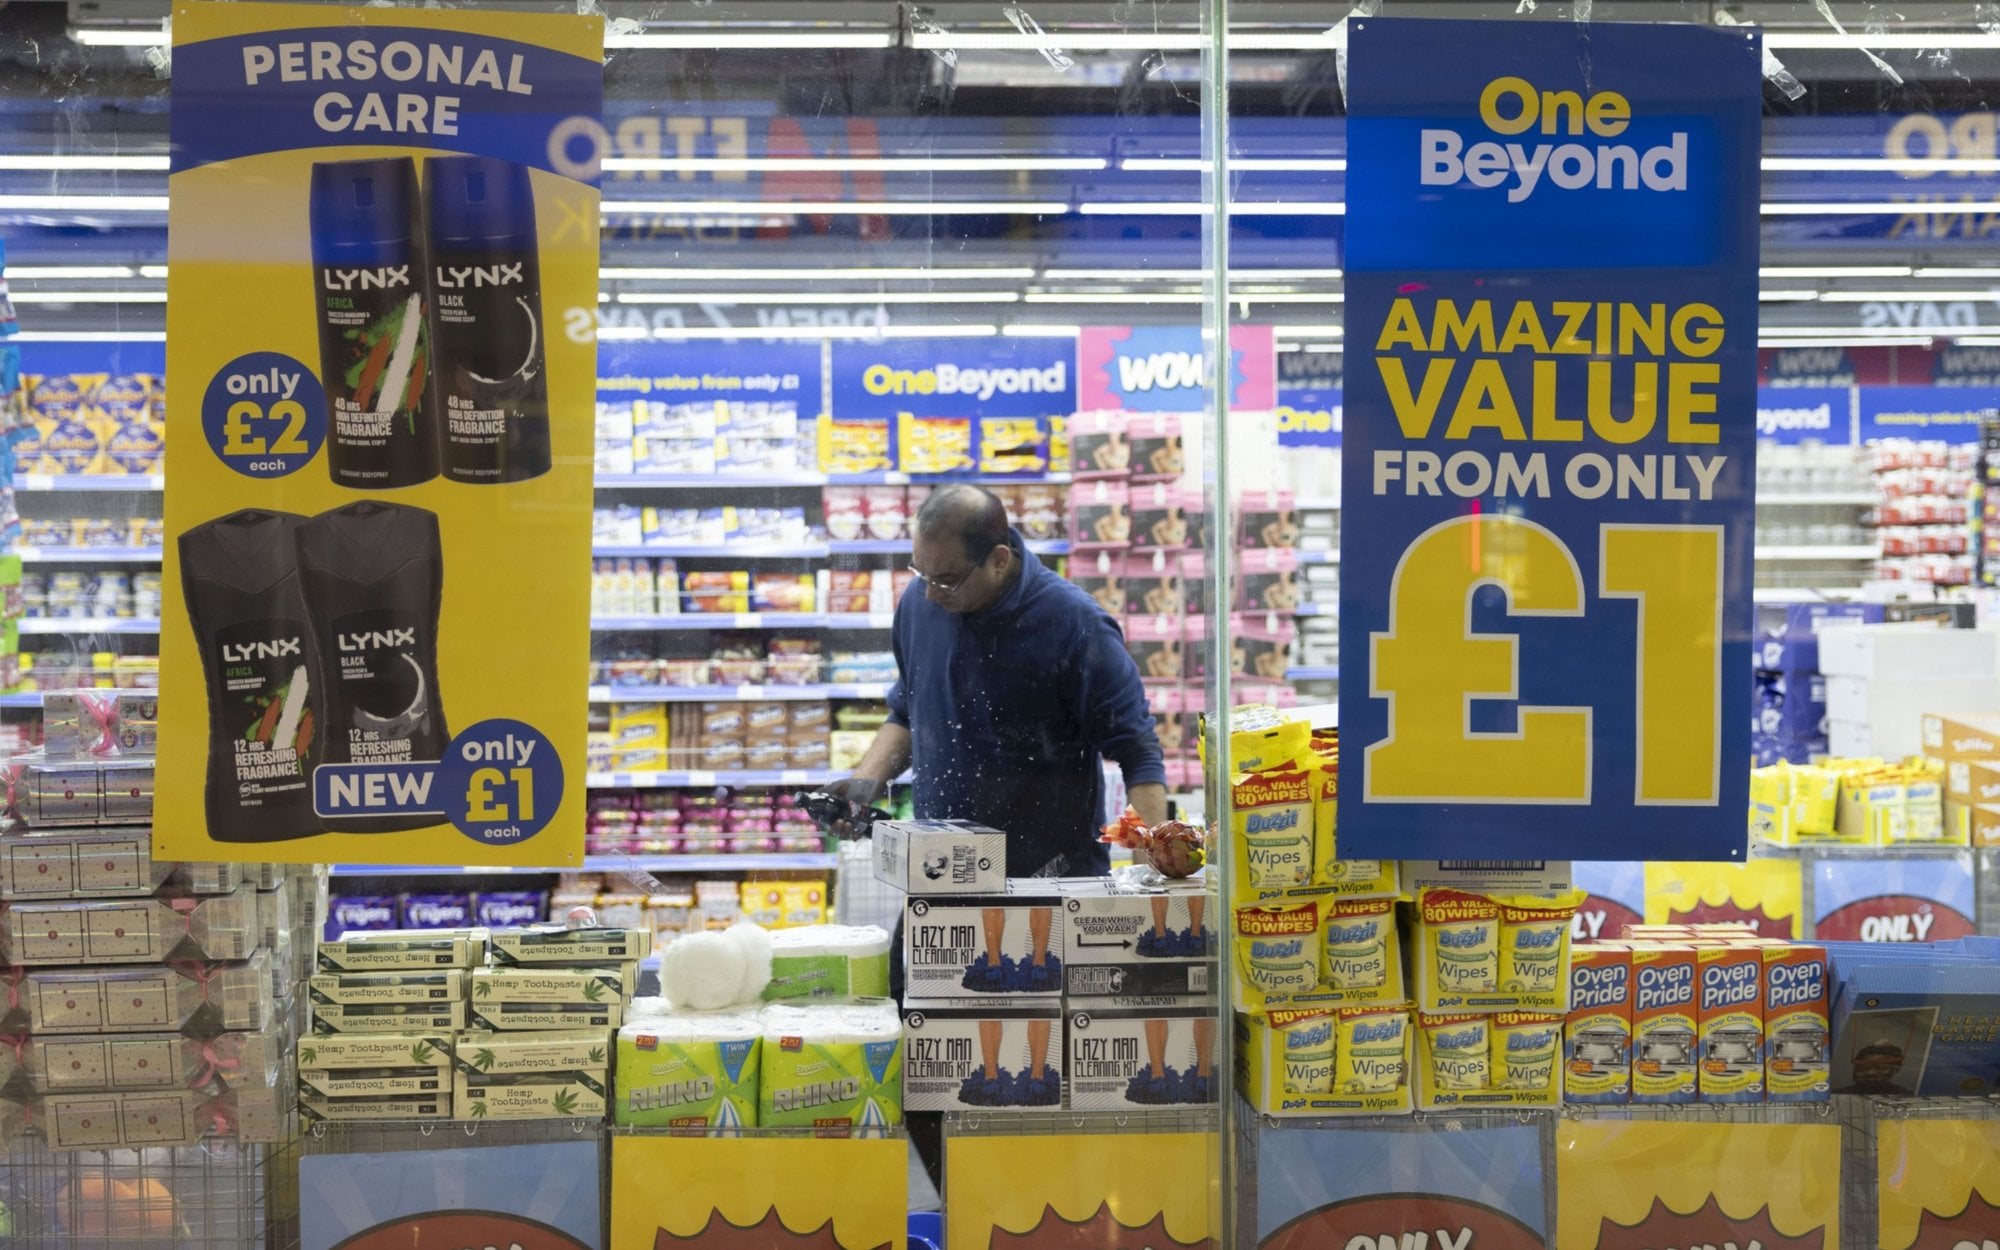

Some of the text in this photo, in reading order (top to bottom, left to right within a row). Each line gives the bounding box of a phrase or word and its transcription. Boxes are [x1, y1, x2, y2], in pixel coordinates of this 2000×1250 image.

[243, 40, 533, 95] PERSONAL
[313, 92, 460, 136] CARE
[1479, 76, 1632, 137] One
[1420, 129, 1688, 203] Beyond
[324, 264, 409, 290] LYNX
[436, 262, 523, 288] LYNX
[438, 294, 464, 307] BLACK
[1375, 298, 1725, 358] AMAZING
[226, 367, 301, 400] only
[334, 396, 346, 411] 48
[447, 394, 474, 409] 48 HRS
[1375, 356, 1721, 444] VALUE
[463, 409, 505, 421] DEFINITION
[223, 400, 308, 456] £2
[336, 421, 393, 436] FRAGRANCE
[449, 420, 506, 435] FRAGRANCE
[249, 459, 287, 472] each
[1373, 450, 1728, 501] FROM ONLY
[223, 636, 301, 662] LYNX
[338, 627, 415, 651] LYNX
[340, 656, 365, 667] BLACK
[1363, 513, 1725, 807] £1
[226, 667, 254, 678] AFRICA
[349, 728, 379, 741] 12 HRS
[233, 739, 265, 752] 12 HRS
[349, 738, 412, 756] REFRESHING
[461, 734, 537, 766] only
[235, 748, 297, 767] REFRESHING
[236, 761, 299, 781] FRAGRANCE
[329, 772, 435, 808] NEW
[465, 767, 534, 823] £1
[484, 825, 521, 838] each
[1246, 809, 1299, 834] Duzzit
[1249, 850, 1301, 869] Wipes
[1340, 883, 1375, 894] Wipes
[1073, 916, 1105, 926] CLEAN
[1276, 912, 1313, 922] VALUE
[912, 925, 976, 948] LAZY MAN
[1082, 924, 1104, 935] YOU
[1327, 922, 1378, 946] Duzzit
[1438, 926, 1488, 948] Duzzit
[1860, 913, 1935, 943] ONLY
[345, 954, 431, 964] Hemp Toothpaste
[520, 945, 604, 955] Hemp Toothpaste
[912, 948, 975, 965] CLEANING KIT
[1251, 940, 1303, 959] Duzzit
[1251, 968, 1304, 988] Wipes
[1328, 958, 1380, 978] Wipes
[1438, 961, 1488, 983] Wipes
[1573, 965, 1625, 987] Oven
[1640, 965, 1691, 987] Oven
[1704, 963, 1756, 985] Oven
[1770, 962, 1821, 985] Oven
[338, 988, 424, 999] Hemp Toothpaste
[492, 979, 582, 990] Hemp Toothpaste
[1346, 990, 1378, 1001] Wipes
[1522, 995, 1555, 1007] Wipes
[1572, 984, 1626, 1008] Pride
[1638, 984, 1692, 1009] Pride
[1704, 983, 1757, 1008] Pride
[1770, 983, 1822, 1008] Pride
[342, 1017, 428, 1027] Hemp Toothpaste
[1352, 1019, 1402, 1045] Duzzit
[1574, 1016, 1622, 1031] Deep Cleaner
[1641, 1016, 1688, 1031] Deep Cleaner
[1707, 1015, 1754, 1030] Deep Cleaner
[1773, 1014, 1820, 1030] Deep Cleaner
[1287, 1022, 1333, 1049] Duzzit
[1435, 1027, 1484, 1049] Duzzit
[317, 1043, 410, 1055] Hemp Toothpaste
[907, 1038, 941, 1061] LAZY
[946, 1038, 972, 1061] MAN
[1074, 1037, 1138, 1061] LAZY MAN
[497, 1056, 588, 1068] Hemp Toothpaste
[907, 1061, 972, 1078] CLEANING KIT
[1074, 1060, 1138, 1078] CLEANING KIT
[1352, 1060, 1402, 1080] Wipes
[1434, 1060, 1484, 1080] Wipes
[1286, 1063, 1336, 1083] Wipes
[490, 1098, 549, 1107] Toothpaste
[506, 1088, 533, 1098] Hemp
[628, 1075, 715, 1113] RHINO
[773, 1075, 860, 1113] RHINO
[1516, 1093, 1548, 1104] Wipes
[1365, 1099, 1399, 1110] Wipes
